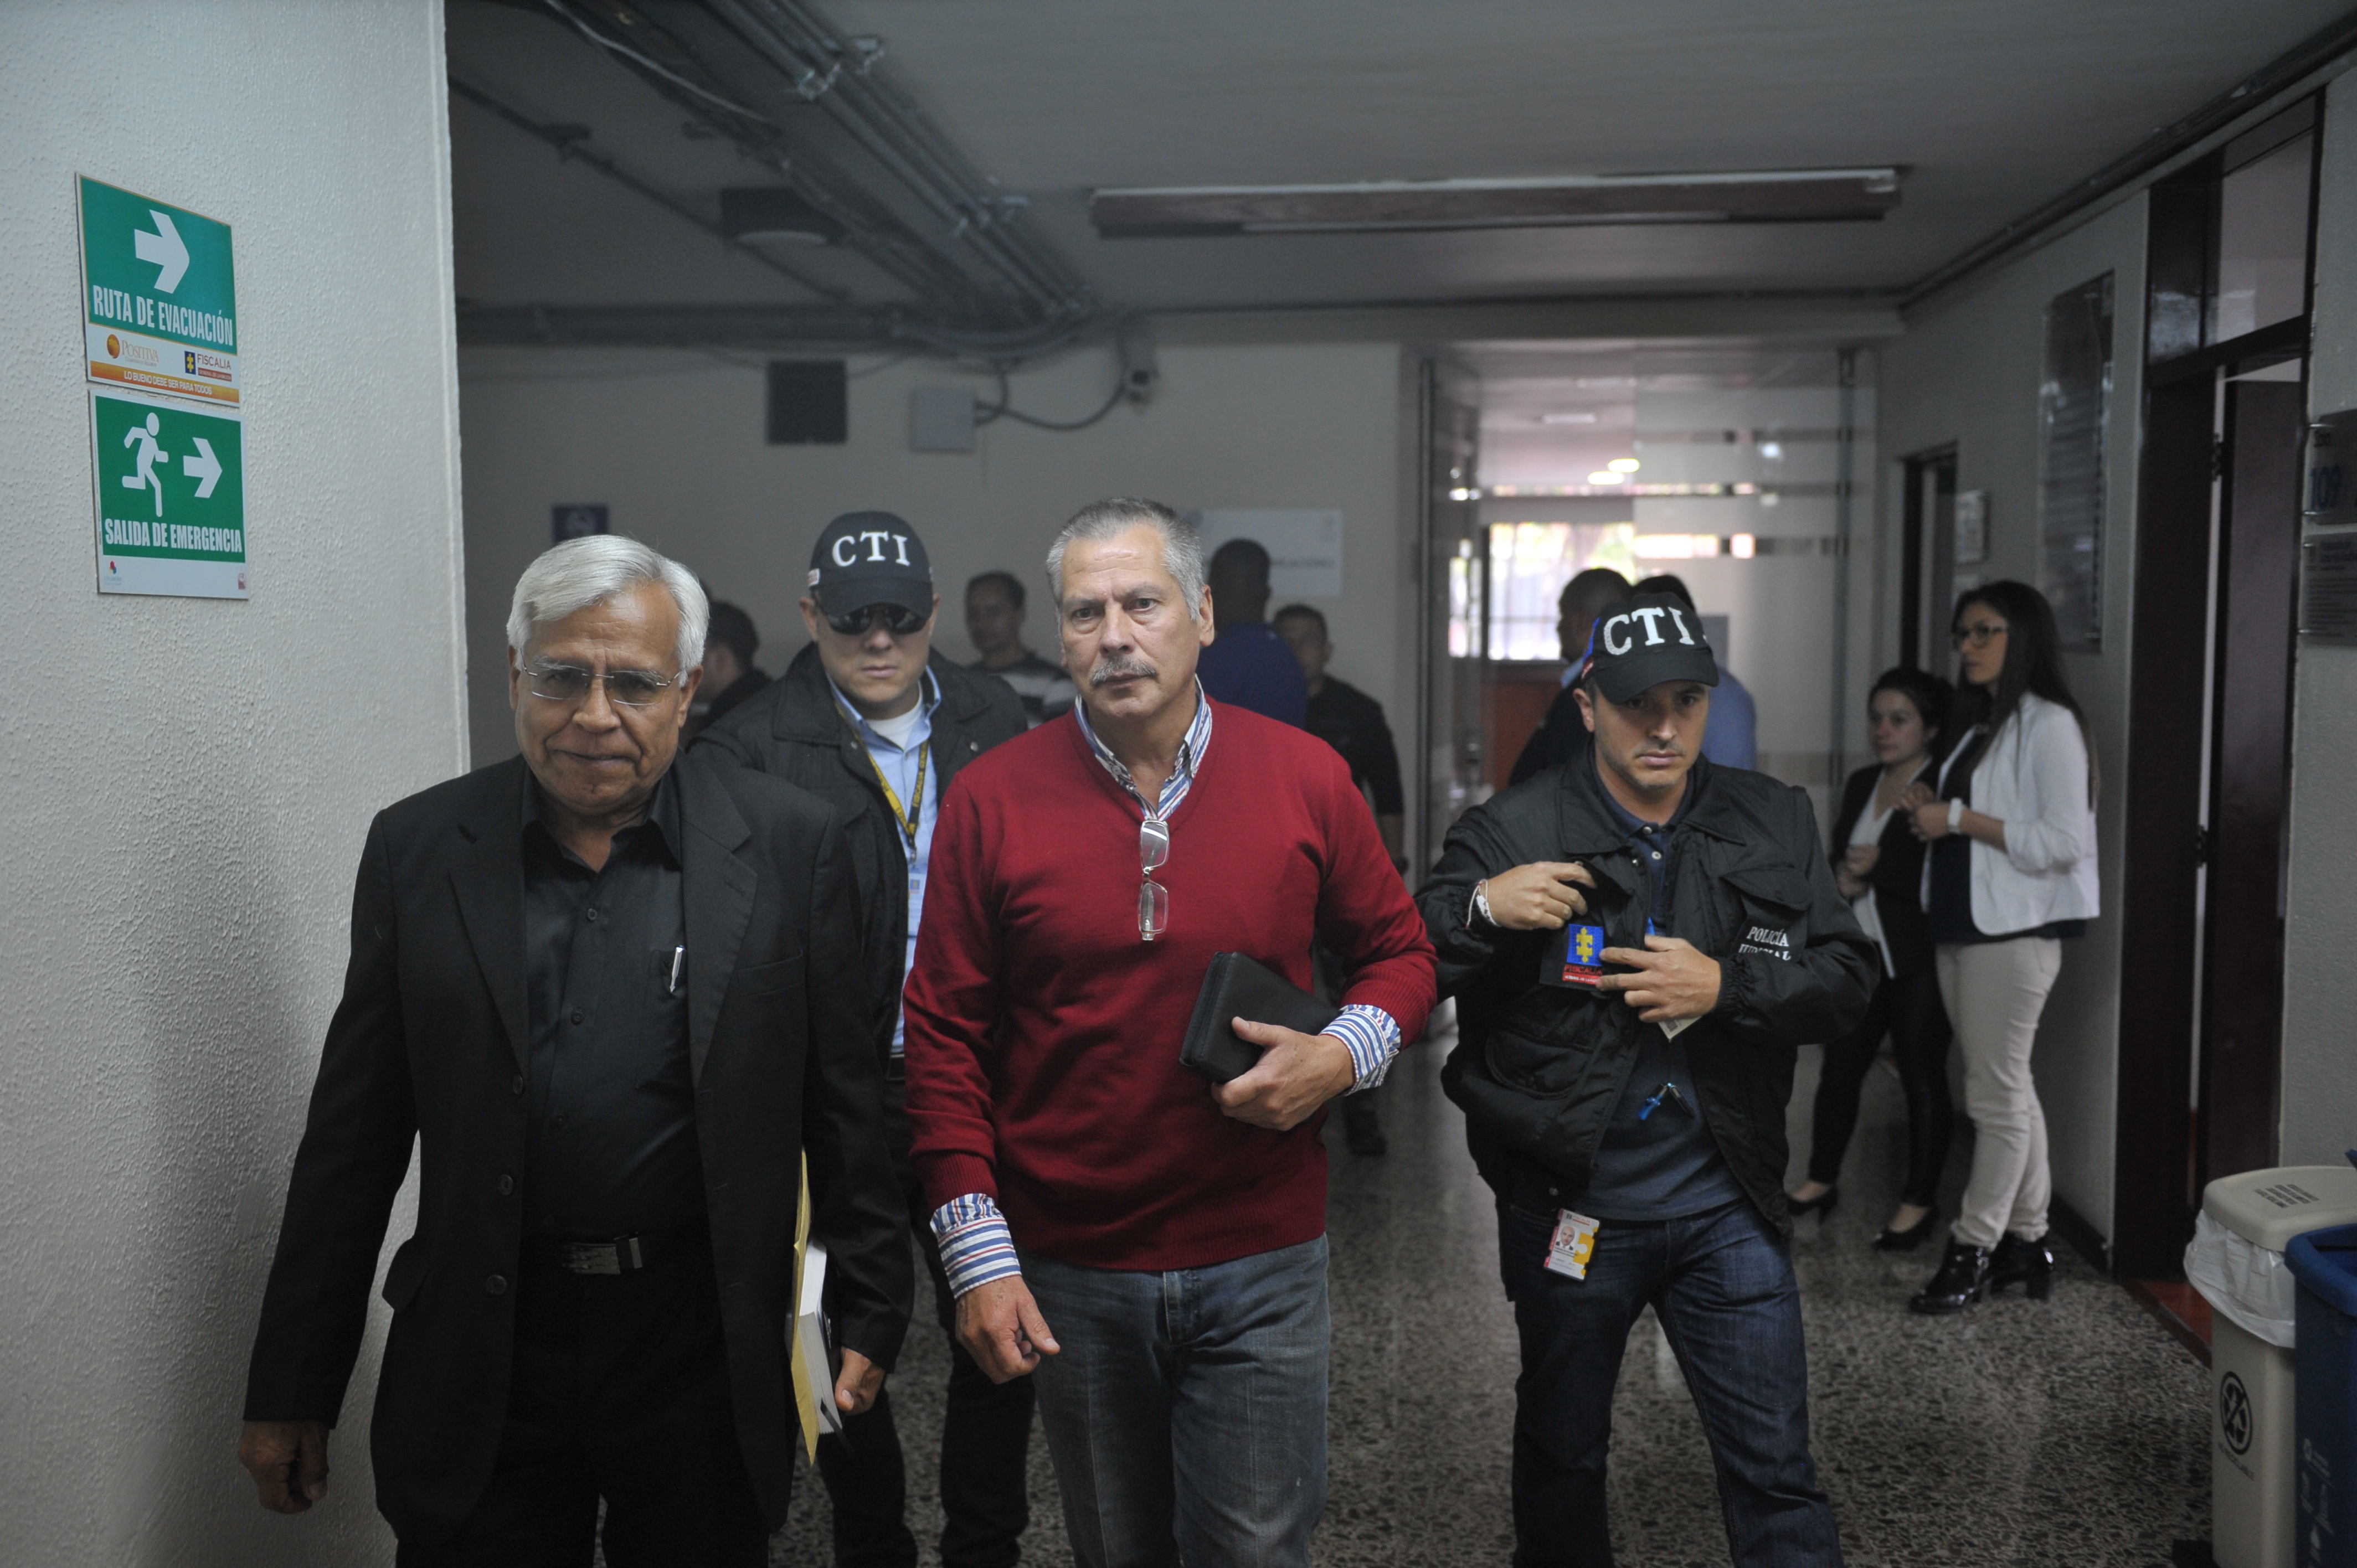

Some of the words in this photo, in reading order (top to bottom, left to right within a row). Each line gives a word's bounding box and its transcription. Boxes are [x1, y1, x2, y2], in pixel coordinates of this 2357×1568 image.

[92, 285, 132, 323] RUTA
[136, 296, 155, 328] DE
[158, 301, 233, 346] EVACUACIÓN
[197, 354, 231, 370] FISCALIA
[124, 370, 132, 380] LO
[133, 372, 152, 384] BUENO
[153, 376, 167, 386] DEBE
[168, 379, 179, 388] SER
[179, 381, 194, 392] PARA
[194, 384, 212, 395] TODOS
[105, 518, 150, 546] SALIDA
[152, 522, 168, 548] DE
[170, 524, 243, 553] EMERGENCIA
[832, 530, 910, 567] CTI
[1603, 606, 1695, 656] CTI
[1746, 926, 1789, 947] POLICÍA
